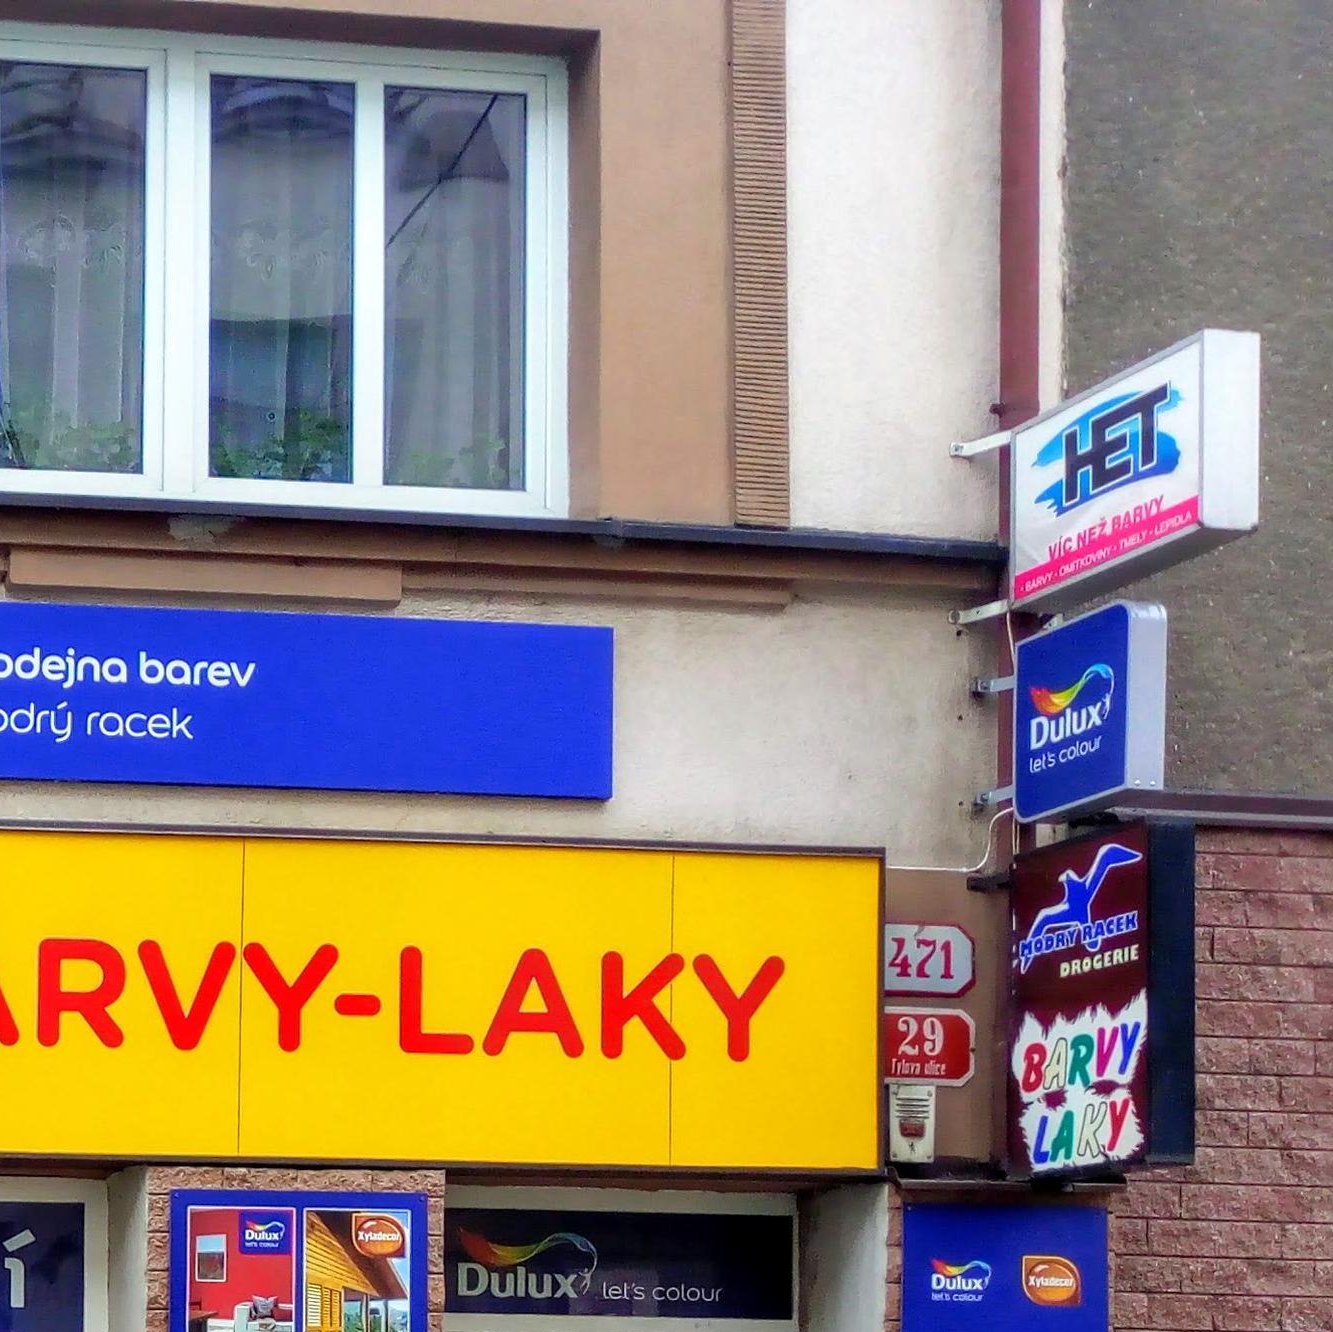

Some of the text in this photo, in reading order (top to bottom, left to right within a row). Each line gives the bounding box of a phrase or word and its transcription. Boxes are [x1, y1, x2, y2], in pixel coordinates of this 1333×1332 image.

[1064, 383, 1170, 504] HET
[1047, 495, 1165, 562] VÍC NEŽ BARVY
[1025, 572, 1053, 593] BARVY
[1119, 531, 1148, 554] TMELY
[1154, 509, 1193, 538] LEPIDLA
[139, 652, 256, 688] barev
[87, 707, 194, 740] racek
[1030, 704, 1102, 750] Dulux
[1029, 733, 1102, 774] let's colour
[1083, 912, 1137, 942] RACEK
[888, 937, 955, 979] 471
[1060, 944, 1140, 977] DROGERIE
[897, 1016, 944, 1055] 29
[891, 1060, 947, 1077] Tylova ulice
[1021, 1021, 1141, 1093] BARVY
[1033, 1098, 1131, 1164] LAKY
[245, 1229, 279, 1240] Dulux
[357, 1231, 400, 1242] Xyladecor
[458, 1262, 724, 1302] Dulux let's colour
[932, 1274, 983, 1291] Dulux
